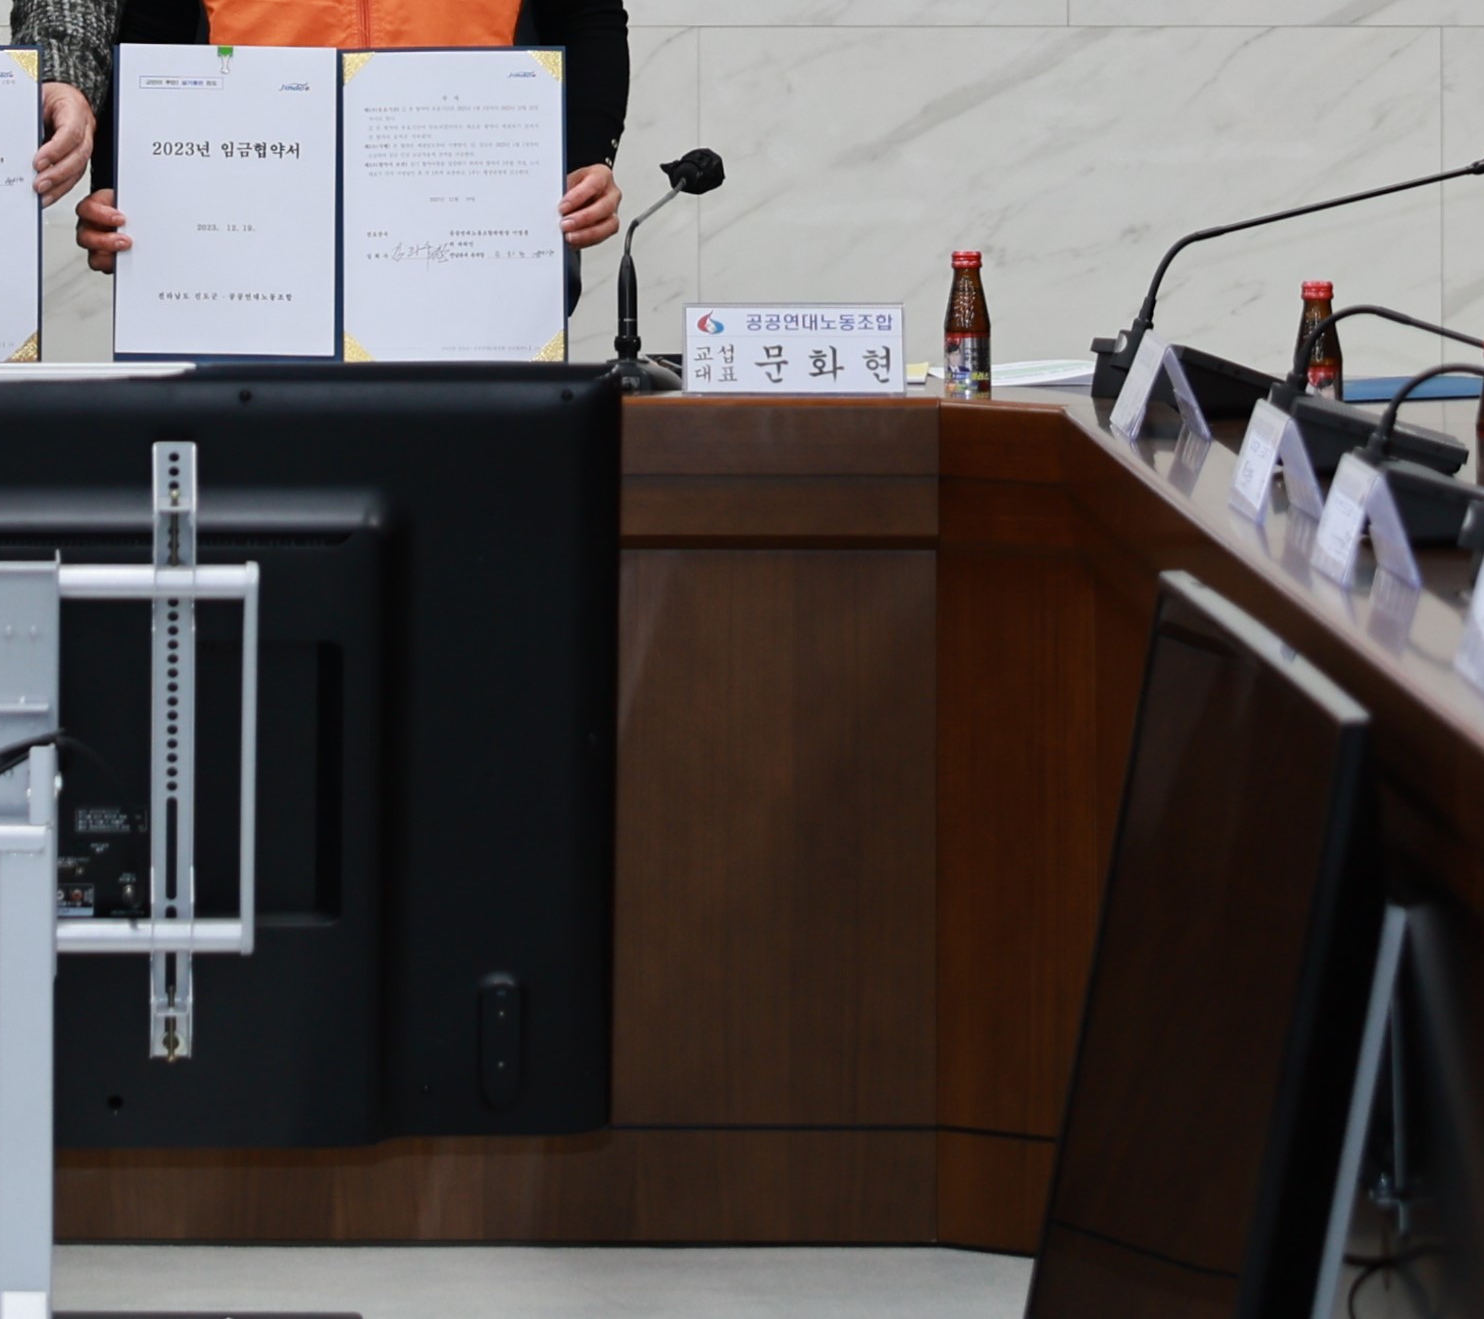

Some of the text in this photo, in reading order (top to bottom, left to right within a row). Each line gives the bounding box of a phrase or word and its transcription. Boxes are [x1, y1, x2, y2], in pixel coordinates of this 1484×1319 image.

[152, 140, 301, 159] 2023년 임금협약서
[746, 313, 893, 332] 공공연대노동조합
[693, 344, 735, 364] 교섭
[694, 365, 738, 384] 대표
